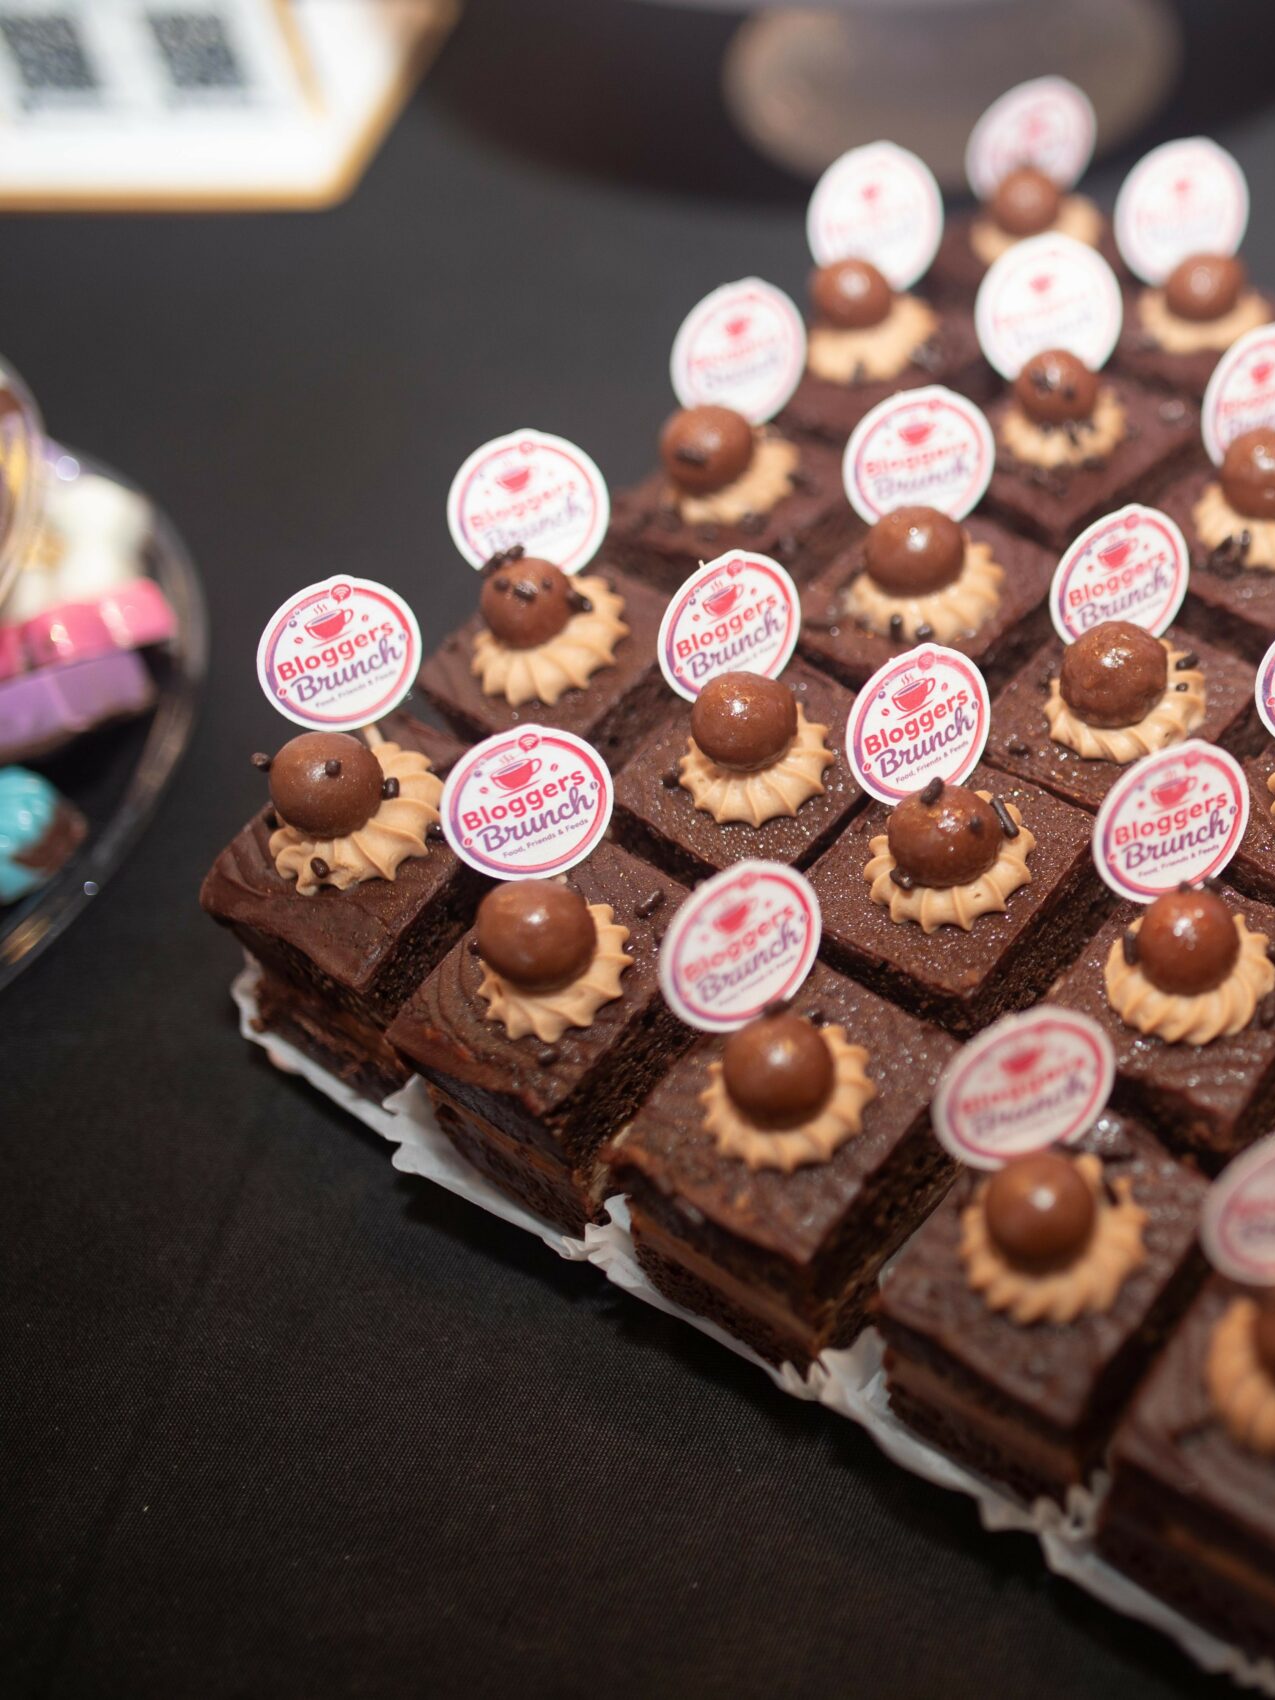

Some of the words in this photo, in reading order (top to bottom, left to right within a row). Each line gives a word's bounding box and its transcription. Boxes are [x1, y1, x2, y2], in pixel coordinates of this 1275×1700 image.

[1069, 551, 1166, 607] Bloggers
[1075, 565, 1169, 630] Brunch
[277, 620, 394, 681] Bloggers
[676, 593, 778, 658] Bloggers
[686, 609, 782, 680] Brunch
[290, 636, 404, 703] Brunch
[864, 689, 968, 756] Bloggers
[874, 706, 975, 778] Brunch
[462, 769, 586, 831] Bloggers
[476, 786, 594, 852] Brunch
[1113, 792, 1228, 846] Bloggers
[1121, 811, 1231, 870] Brunch
[682, 905, 795, 981] Bloggers
[695, 922, 805, 1003] Brunch
